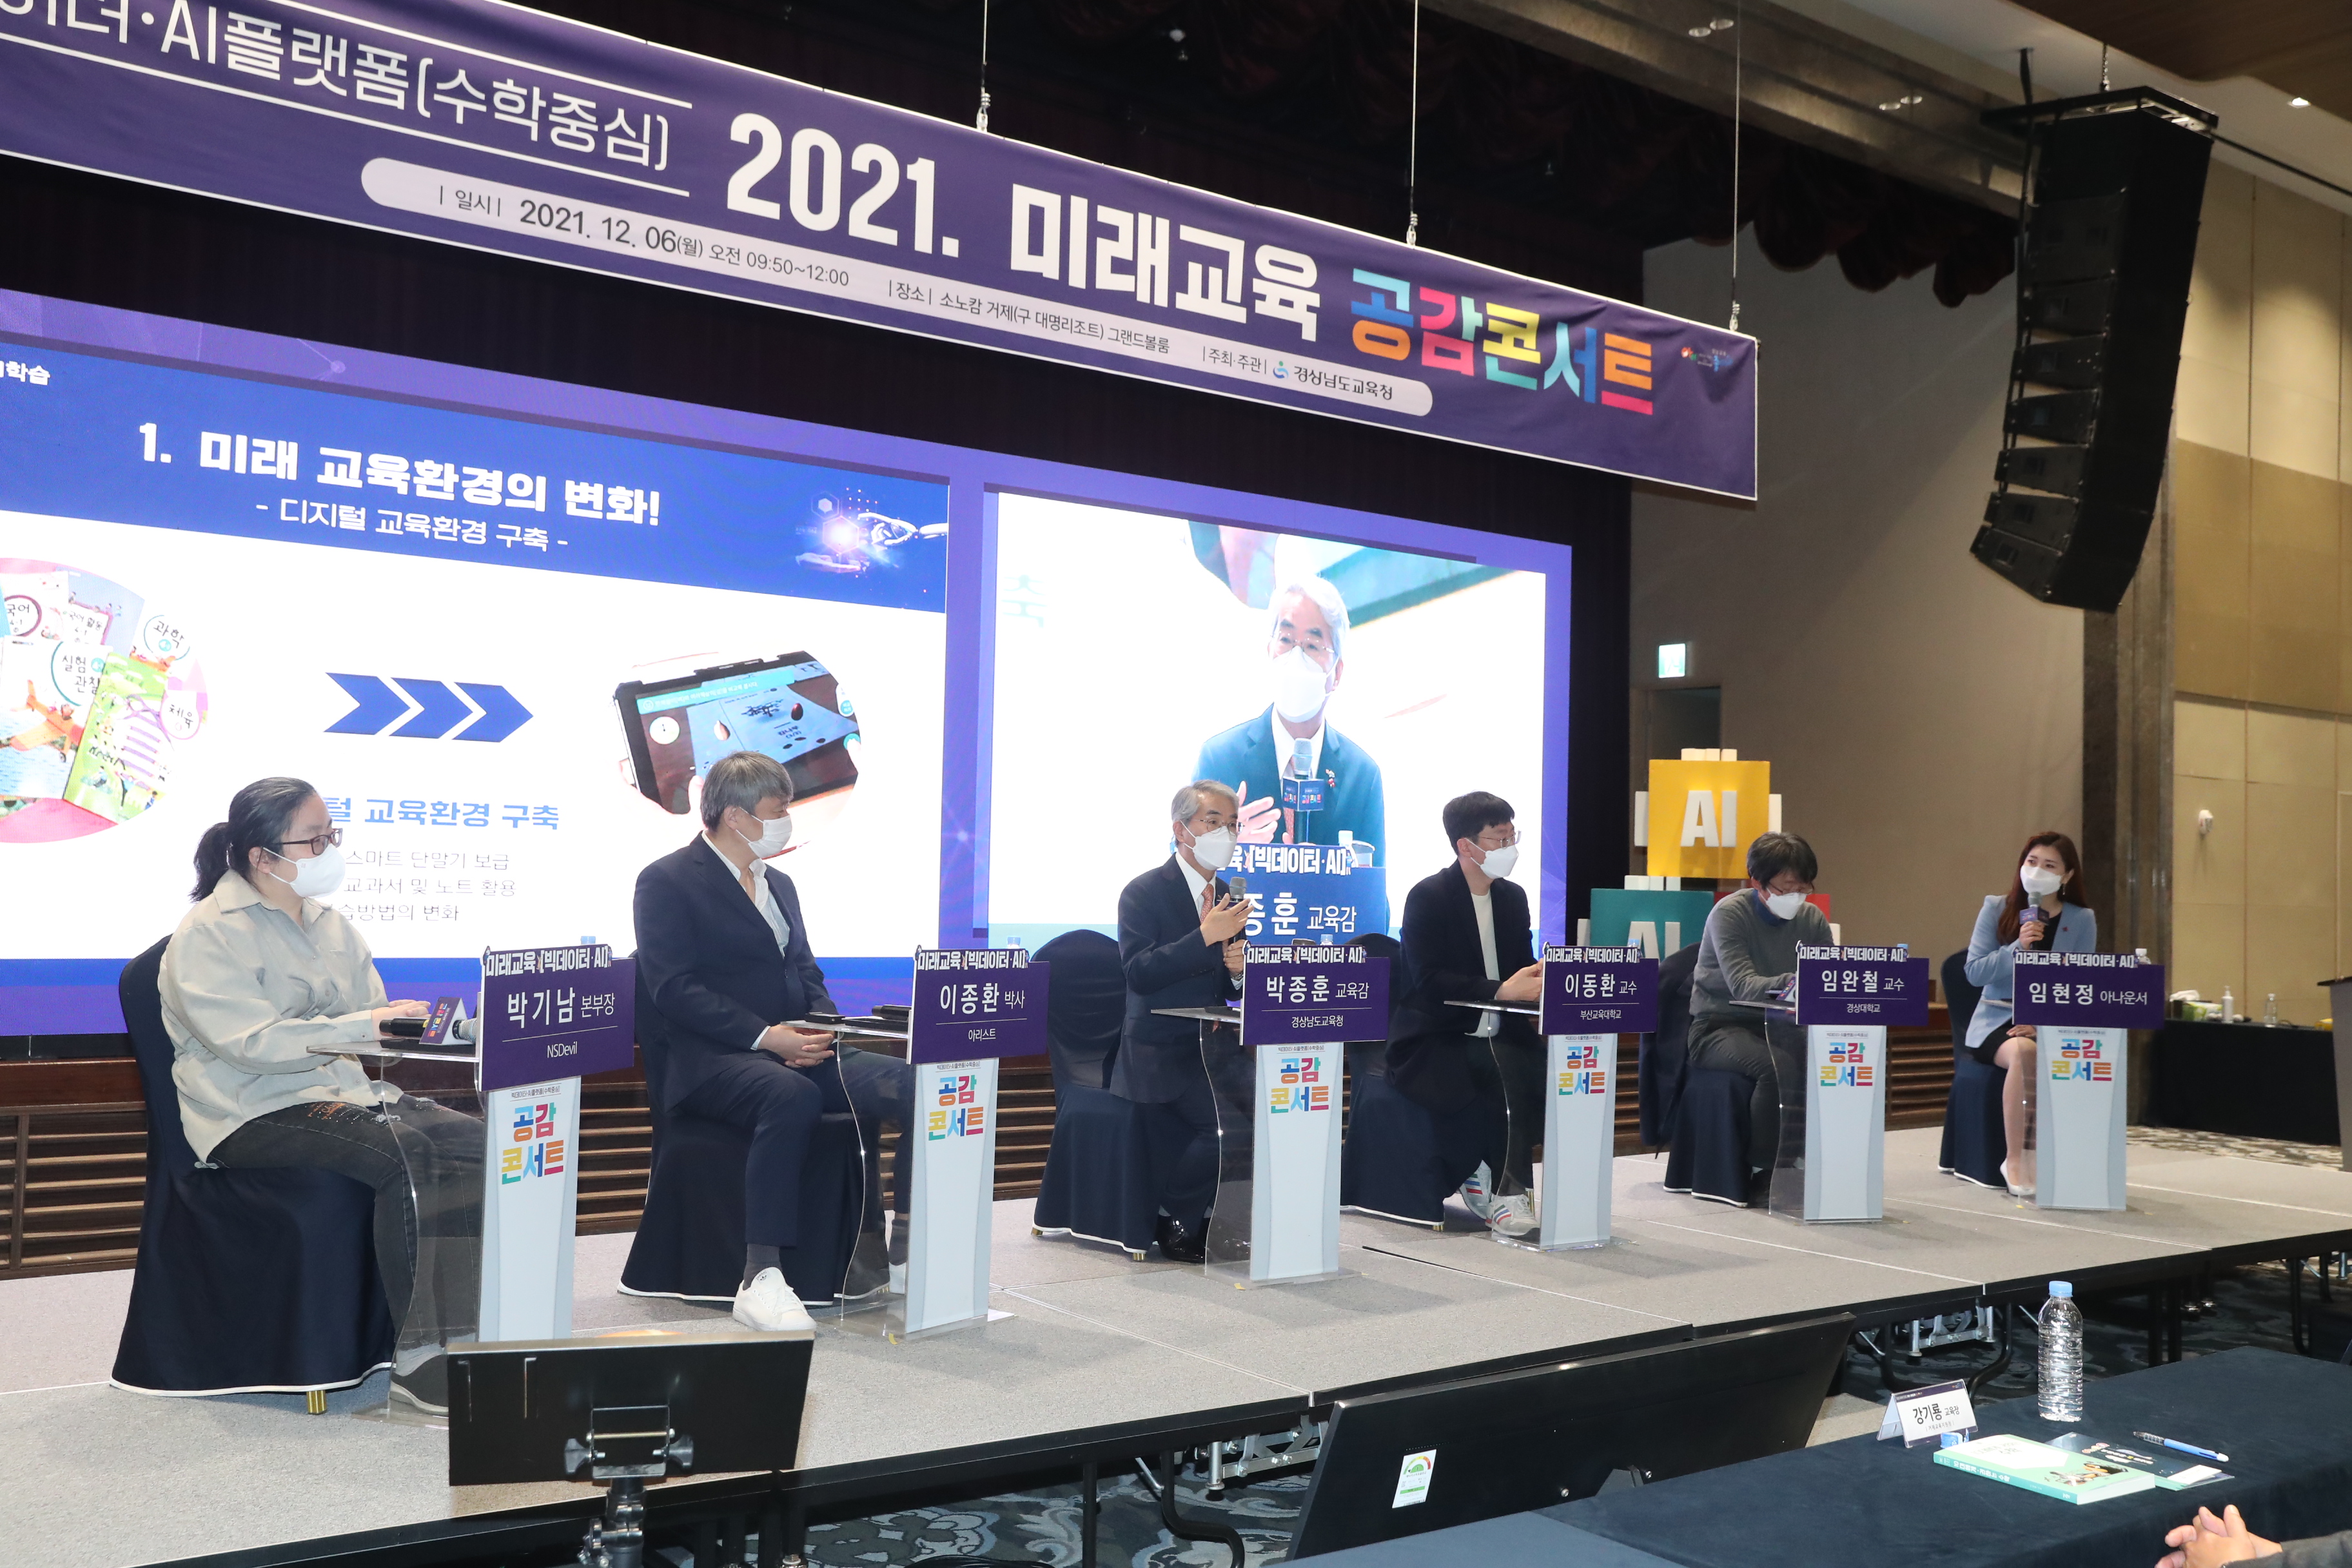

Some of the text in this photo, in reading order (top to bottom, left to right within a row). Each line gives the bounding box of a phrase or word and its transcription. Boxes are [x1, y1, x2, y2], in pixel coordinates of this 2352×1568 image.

[727, 113, 959, 258] 2021.
[1010, 183, 1320, 342] 미래교육
[1351, 268, 1653, 415] 공감콘서트
[520, 199, 591, 239] 2021.
[602, 217, 636, 247] 12.
[646, 226, 703, 258] 06(월)
[709, 244, 740, 266] 오전
[747, 251, 848, 286] 09:50~12:00
[941, 292, 982, 315] 소노캄
[987, 301, 1031, 325] 거제(구
[1035, 310, 1104, 340] 대명리조트)
[1108, 326, 1170, 354] 그랜드볼룸
[1294, 365, 1393, 400] 경상남도교육청
[0, 360, 50, 386] 학습
[139, 422, 660, 527] 1. 미래 교육환경의 변화!
[280, 499, 366, 531] 디지털
[375, 509, 487, 545] 교육환경
[495, 523, 549, 552] 구축
[153, 620, 184, 649] 과학
[62, 655, 86, 673] 실험
[169, 704, 193, 729] 체육
[365, 799, 489, 827] 교육환경
[502, 805, 559, 830] 구축
[1681, 790, 1737, 847] AI
[346, 851, 509, 870] 스마트 단말기 보급
[344, 878, 516, 897] 교과서 및 노트 활용
[424, 905, 459, 921] 변화
[1306, 905, 1357, 933] 교육감
[485, 951, 536, 977] 미래교육
[917, 951, 961, 971] 미래교육
[1246, 946, 1292, 964] 미래교육
[1546, 948, 1583, 963] 미래교육
[1799, 946, 1841, 960] 미래교육
[2015, 952, 2061, 966] 미래교육
[1266, 975, 1369, 1003] 박종훈 교육감
[1565, 973, 1637, 998] 이동환 교수
[1821, 970, 1905, 993] 임완철 교수
[939, 983, 1025, 1015] 이종환 박사
[2029, 983, 2148, 1006] 임현정 아나운서
[507, 986, 615, 1029] 박기남 본부장
[1580, 1009, 1622, 1021] 부산교육대학교
[1847, 1003, 1881, 1014] 경상대학교
[1291, 1015, 1344, 1028] 경상남도교육청
[968, 1028, 996, 1042] 아리스트
[547, 1041, 578, 1059] NSDevil
[1567, 1046, 1599, 1070] 공감
[1829, 1042, 1865, 1063] 공감
[2061, 1038, 2102, 1059] 공감
[1281, 1057, 1321, 1084] 공감
[1820, 1065, 1873, 1086] 콘서트
[2051, 1060, 2112, 1081] 콘서트
[939, 1075, 977, 1106] 공감
[1558, 1072, 1605, 1095] 콘서트
[1270, 1086, 1329, 1114] 콘서트
[513, 1102, 556, 1142] 공감
[928, 1106, 984, 1141] 콘서트
[501, 1139, 564, 1185] 콘서트
[1912, 1403, 1960, 1424] 강기룡 교육장
